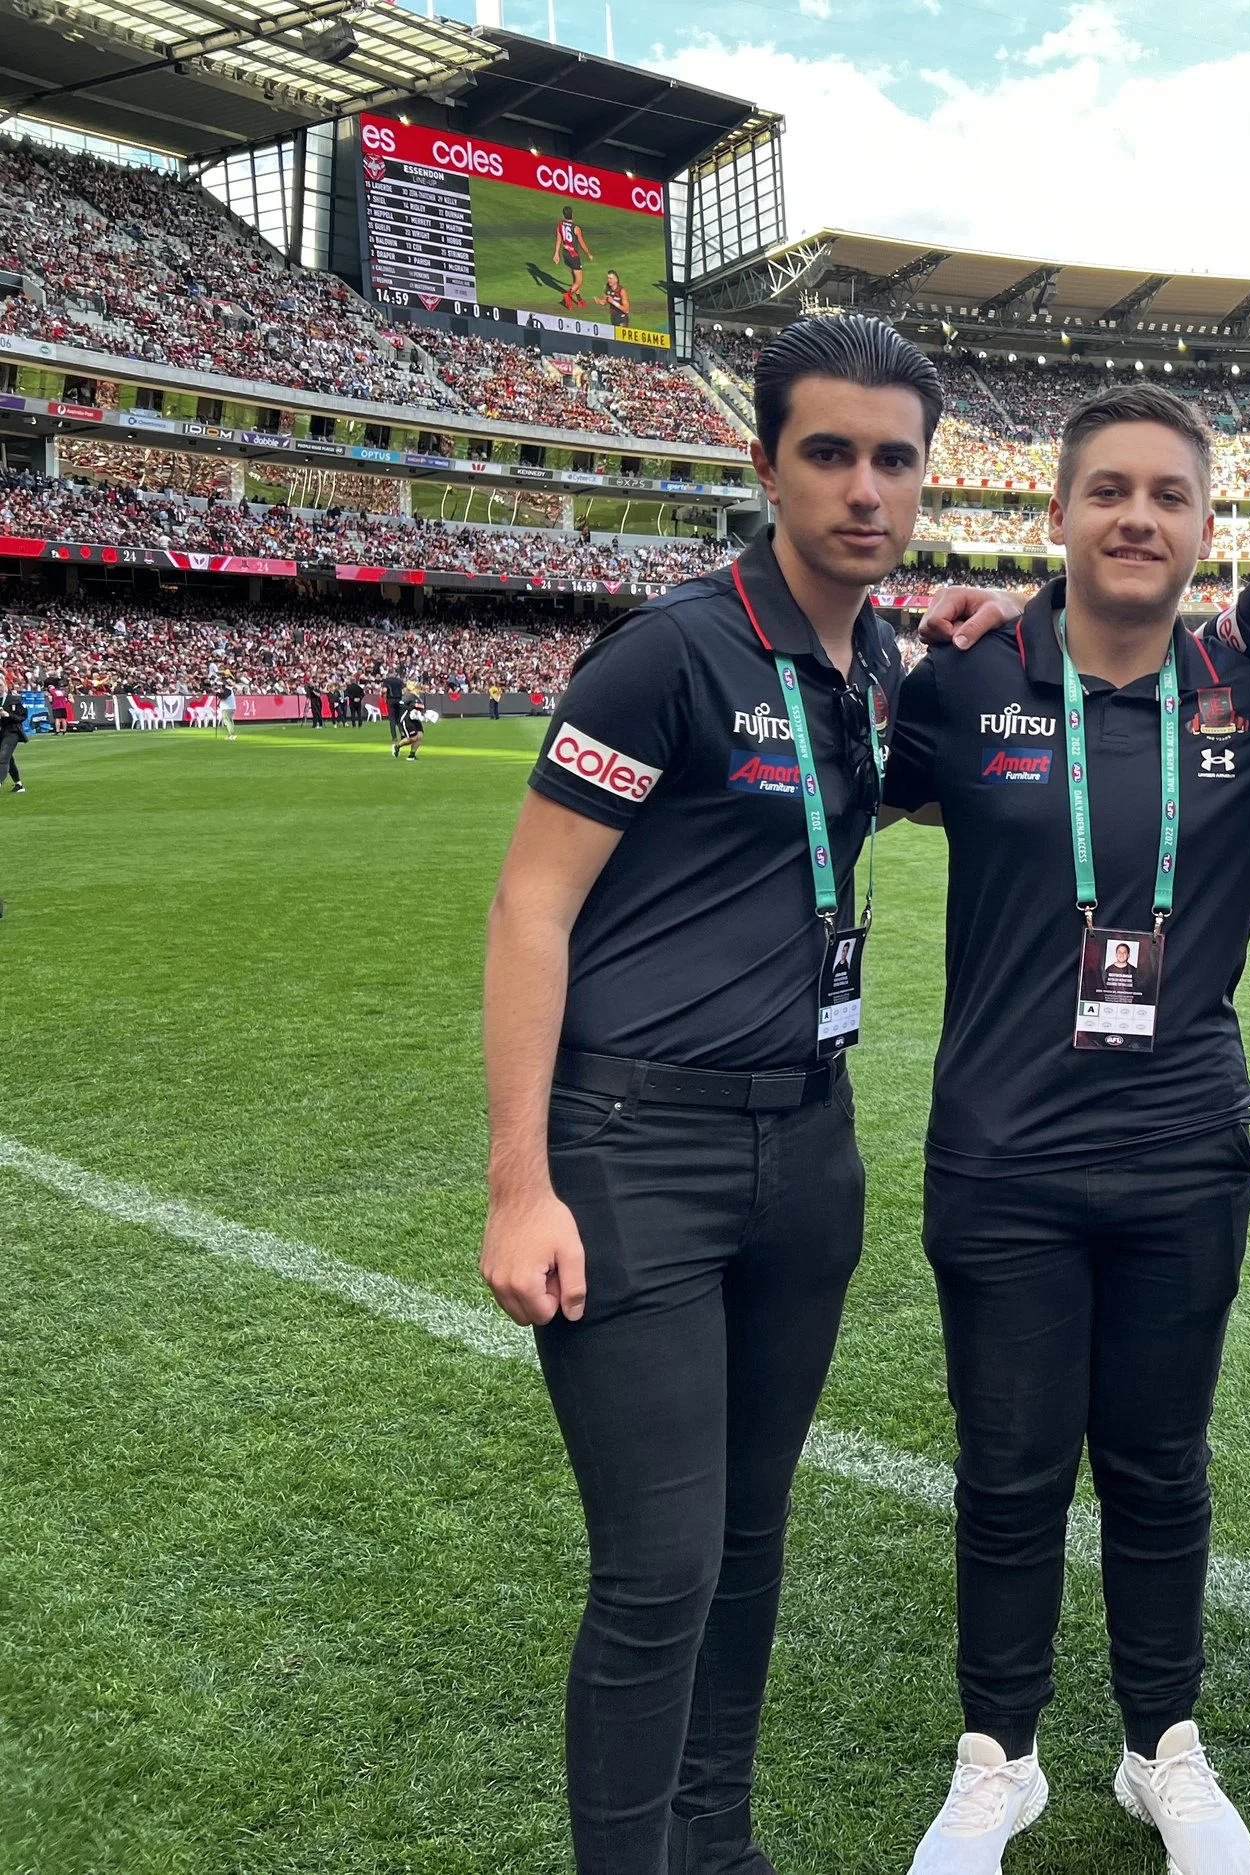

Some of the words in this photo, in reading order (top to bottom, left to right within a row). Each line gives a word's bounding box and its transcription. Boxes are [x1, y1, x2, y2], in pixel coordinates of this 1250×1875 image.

[432, 140, 504, 176] coles
[403, 165, 444, 180] ESSENDON
[412, 176, 437, 186] LINE-UP
[536, 165, 601, 198] coles
[376, 288, 409, 306] 14:59
[622, 328, 639, 342] PRE
[641, 332, 665, 346] GAME
[184, 424, 232, 439] IDIOM
[360, 449, 391, 461] OPTUS
[517, 468, 546, 477] KENNEDY
[123, 550, 137, 562] 24
[572, 581, 597, 592] 14:59
[784, 669, 794, 689] AFL
[80, 701, 96, 720] 24
[542, 696, 555, 710] 24
[1165, 696, 1173, 713] AFL
[791, 705, 803, 733] ACCESS
[980, 702, 1056, 739] FUJITSU
[1070, 711, 1079, 728] AFL
[1166, 722, 1174, 746] ACCESS
[798, 735, 809, 758] ARENA
[1070, 737, 1080, 755] 2022
[555, 737, 652, 800] coles
[982, 752, 1050, 776] Amart
[1073, 764, 1081, 782] AFL
[806, 775, 816, 795] AFL
[1005, 771, 1041, 781] Furniture
[1167, 771, 1175, 793] DAILY
[760, 781, 795, 793] Furniture
[1074, 790, 1083, 811] DAILY
[812, 810, 822, 832] 2022
[1076, 811, 1085, 837] ARENA
[1164, 827, 1174, 846] 2022
[816, 846, 827, 867] AFL
[1077, 837, 1088, 863] ACCESS
[1162, 854, 1170, 872] AFL
[1107, 1036, 1122, 1044] AFL
